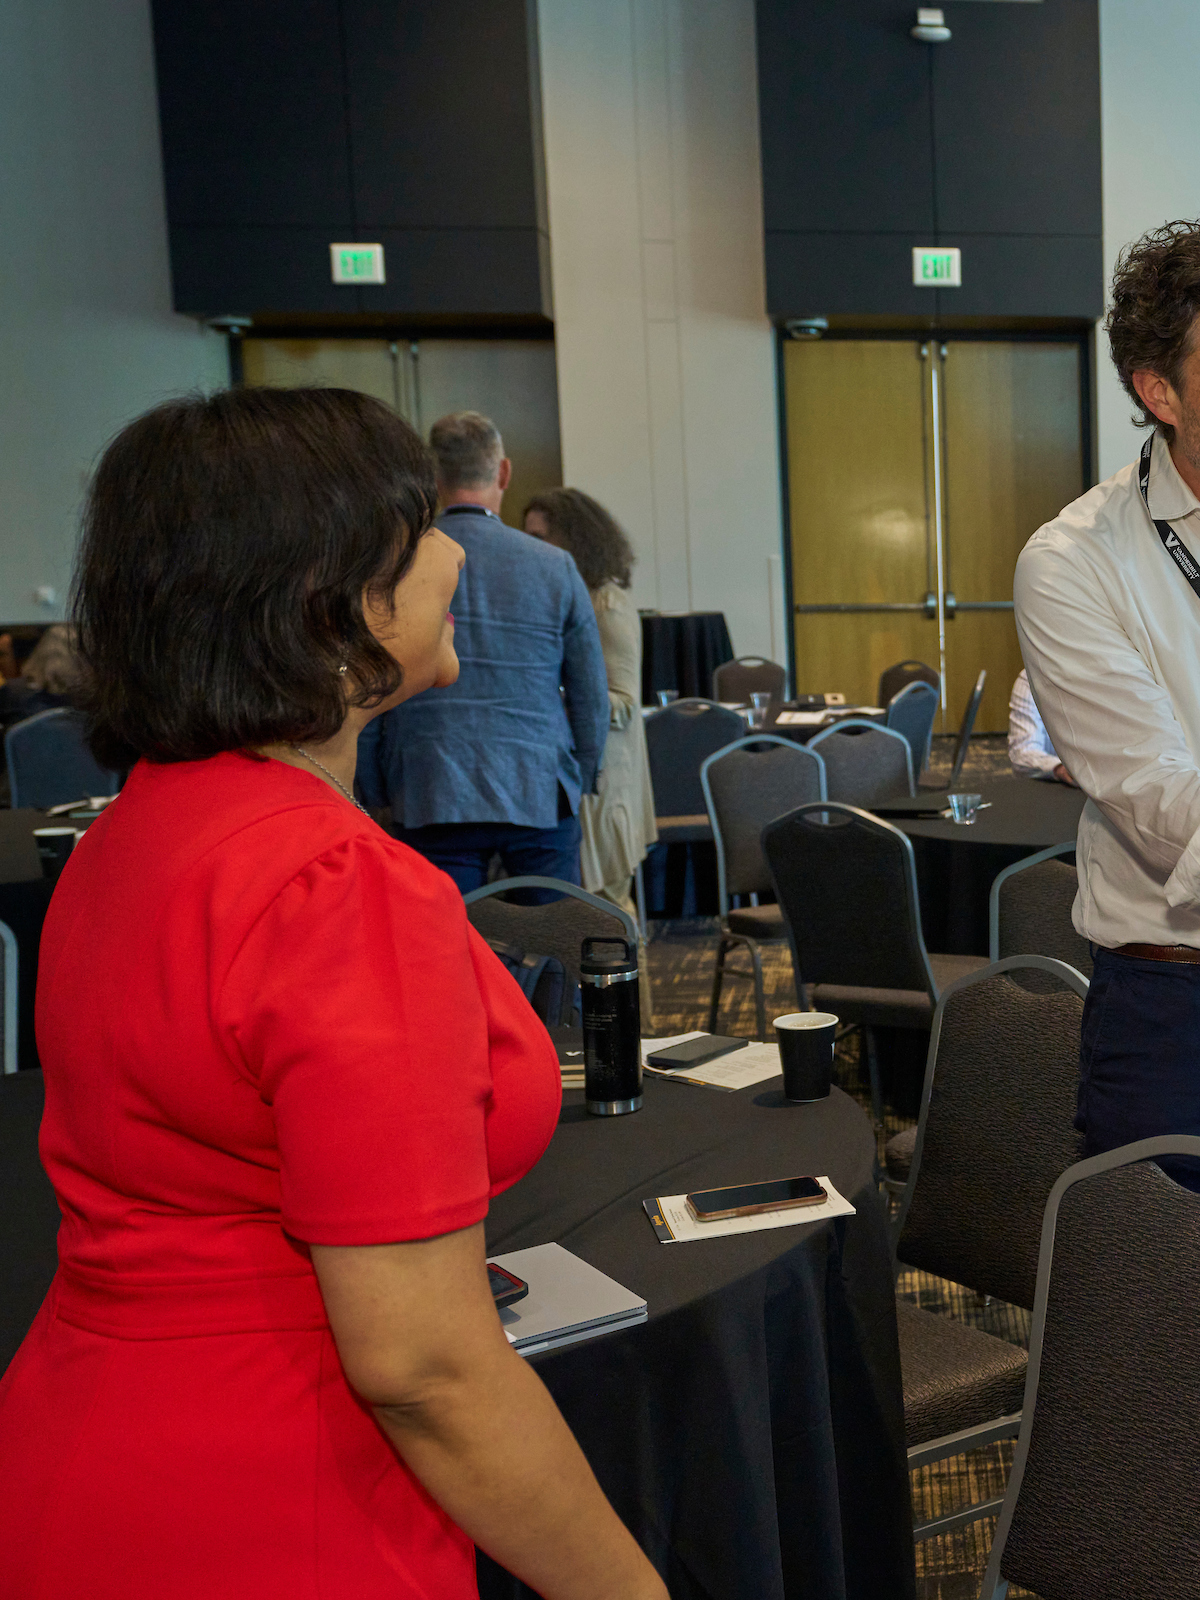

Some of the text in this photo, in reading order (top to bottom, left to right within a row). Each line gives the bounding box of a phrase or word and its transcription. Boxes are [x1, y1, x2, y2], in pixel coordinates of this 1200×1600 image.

[922, 254, 952, 278] EXIT
[1165, 531, 1180, 548] V
[1172, 549, 1196, 580] UNIVERSITY
[1176, 546, 1200, 578] VANDERBILT
